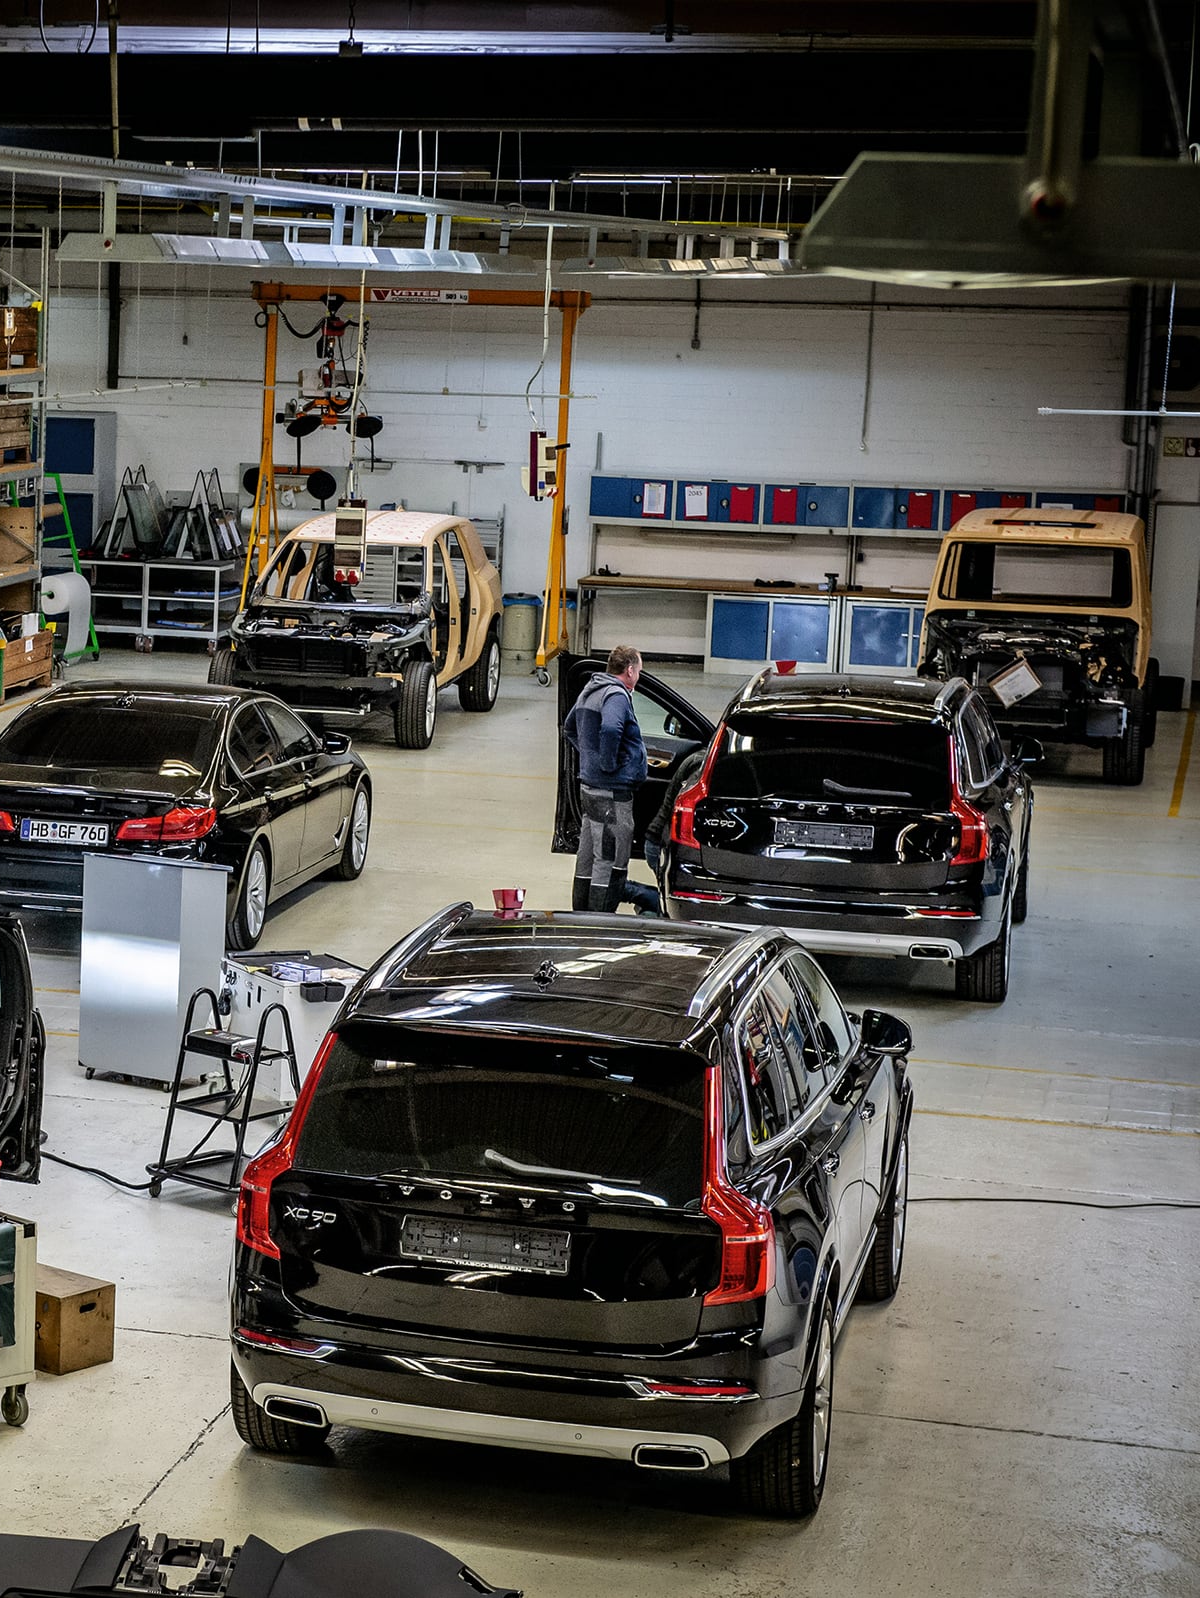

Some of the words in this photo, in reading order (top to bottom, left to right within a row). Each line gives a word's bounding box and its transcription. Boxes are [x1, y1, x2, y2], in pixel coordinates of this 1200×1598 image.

[30, 822, 49, 837] HB
[58, 824, 77, 839] GF
[80, 826, 106, 841] 760
[400, 1185, 575, 1211] VOLVO
[283, 1205, 337, 1224] XC90
